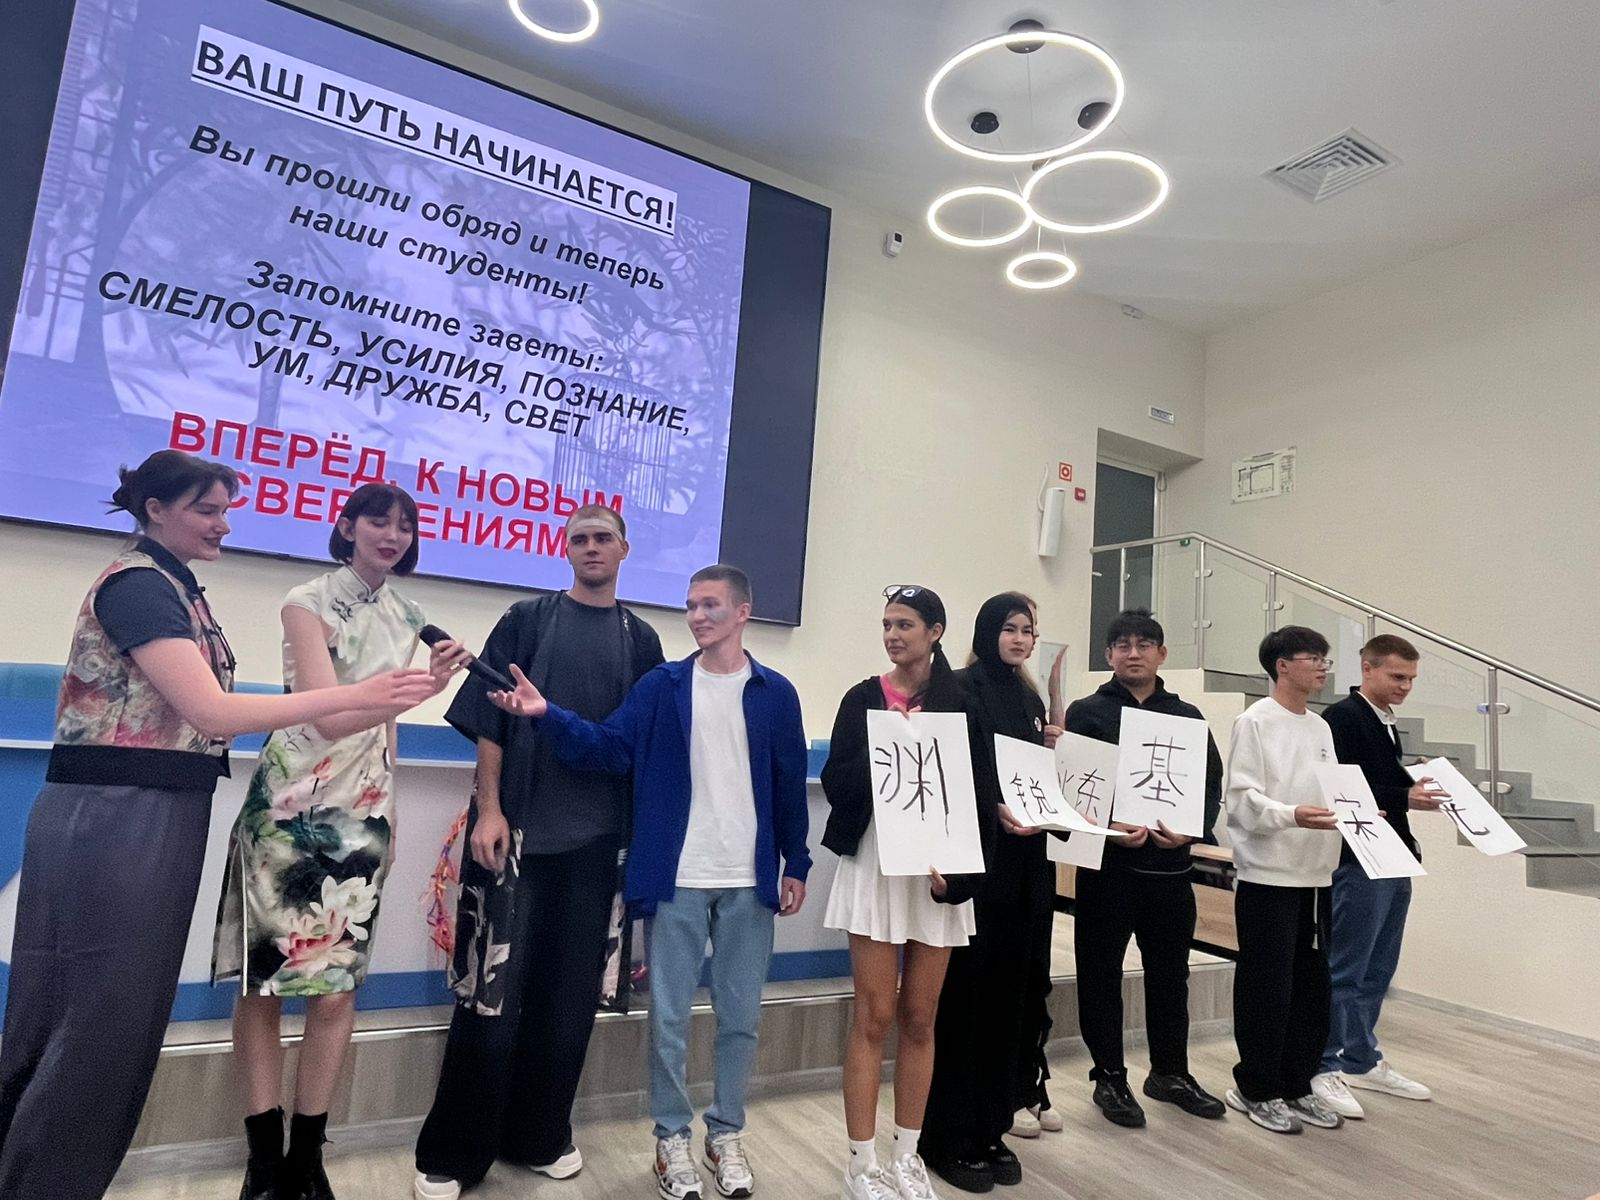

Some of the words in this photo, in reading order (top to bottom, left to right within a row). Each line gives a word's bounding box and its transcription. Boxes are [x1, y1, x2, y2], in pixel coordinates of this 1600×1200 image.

[197, 40, 304, 104] ВАШ
[317, 82, 422, 142] ПУТЬ
[433, 121, 674, 229] НАЧИНАЕТСЯ!
[189, 124, 256, 167] Вы
[264, 153, 412, 213] прошли
[421, 201, 522, 246] обряд
[529, 234, 549, 255] и
[555, 242, 665, 291] теперь
[289, 205, 389, 249] наши
[398, 235, 589, 305] студенты!
[98, 270, 342, 356] СМЕЛОСТЬ,
[355, 331, 507, 394] УСИЛИЯ,
[519, 371, 690, 436] ПОЗНАНИЕ,
[247, 260, 462, 337] Запомните
[469, 322, 604, 373] заветы:
[248, 341, 315, 385] УМ,
[322, 360, 491, 424] ДРУЖБА,
[504, 399, 591, 438] СВЕТ
[416, 457, 445, 495] К
[1130, 736, 1188, 807] 基
